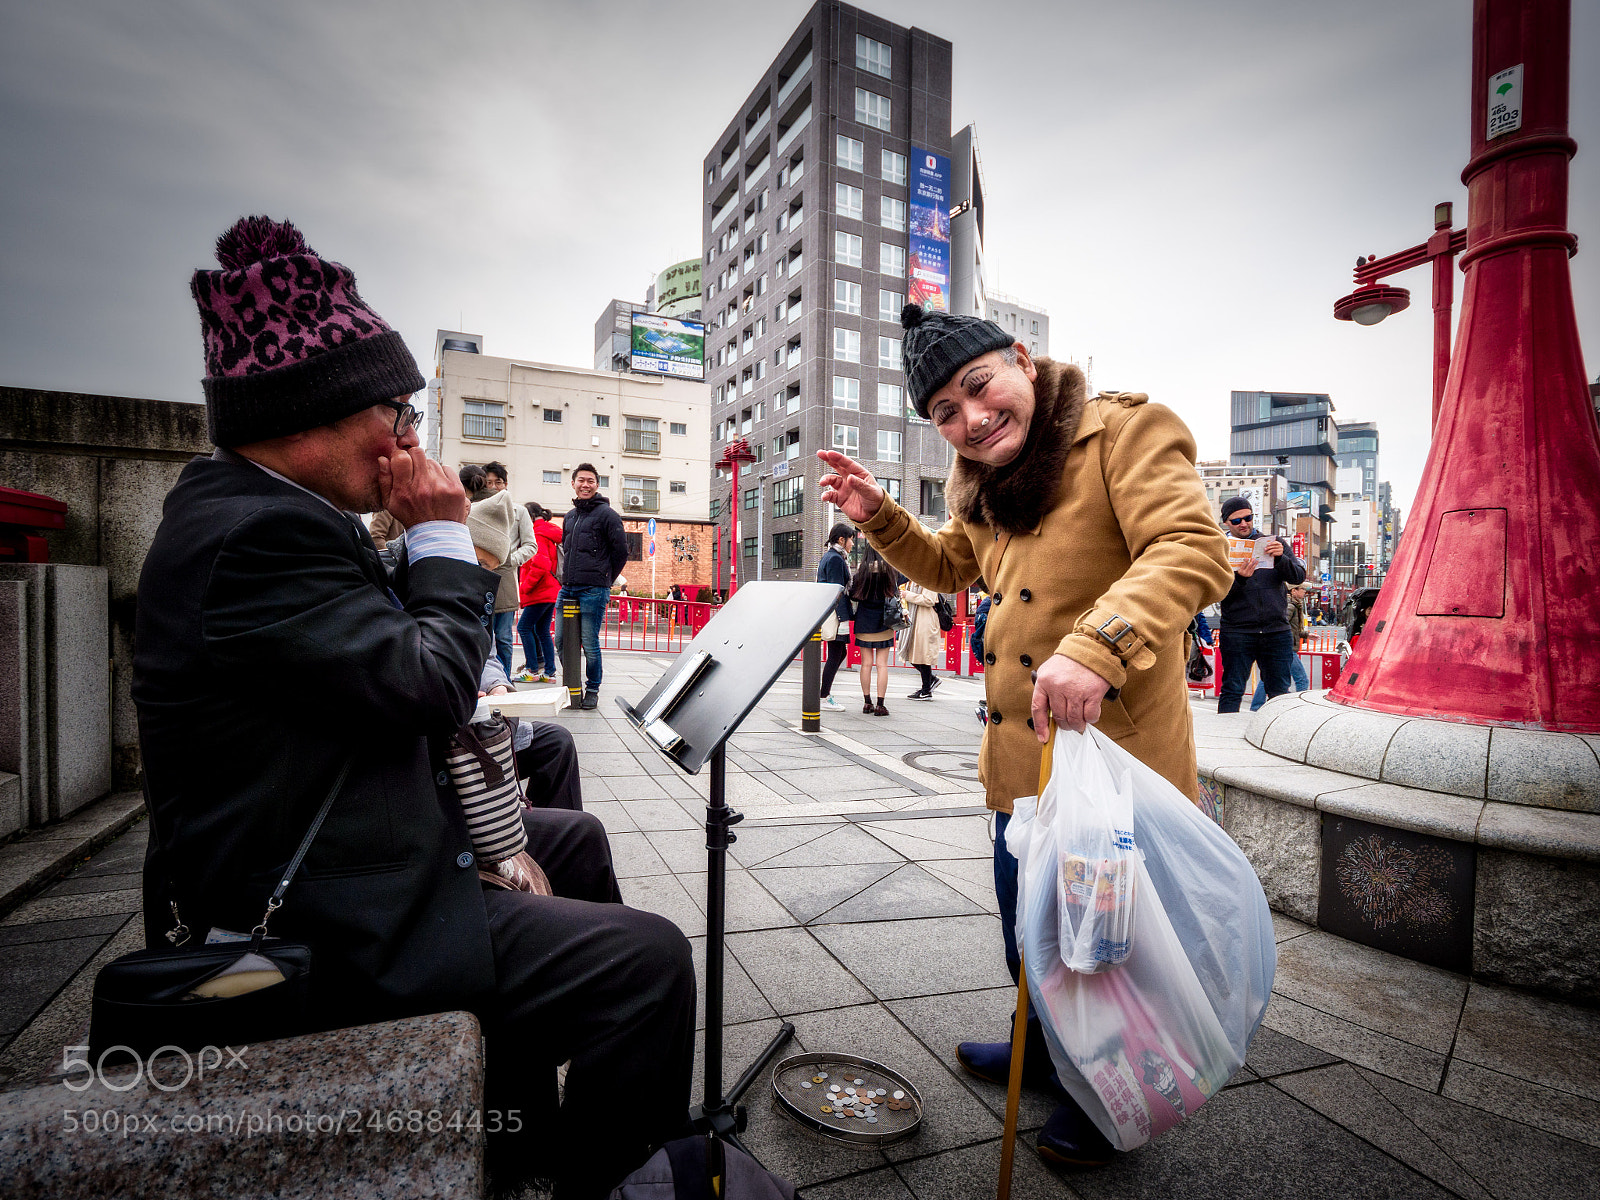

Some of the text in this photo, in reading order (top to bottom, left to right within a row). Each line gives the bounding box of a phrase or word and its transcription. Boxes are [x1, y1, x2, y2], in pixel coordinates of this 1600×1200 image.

[1490, 109, 1519, 127] 2103
[1491, 105, 1507, 116] 463
[927, 245, 942, 254] PASS
[666, 263, 702, 280] カプセルホ
[1094, 1070, 1130, 1126] 雪国体験
